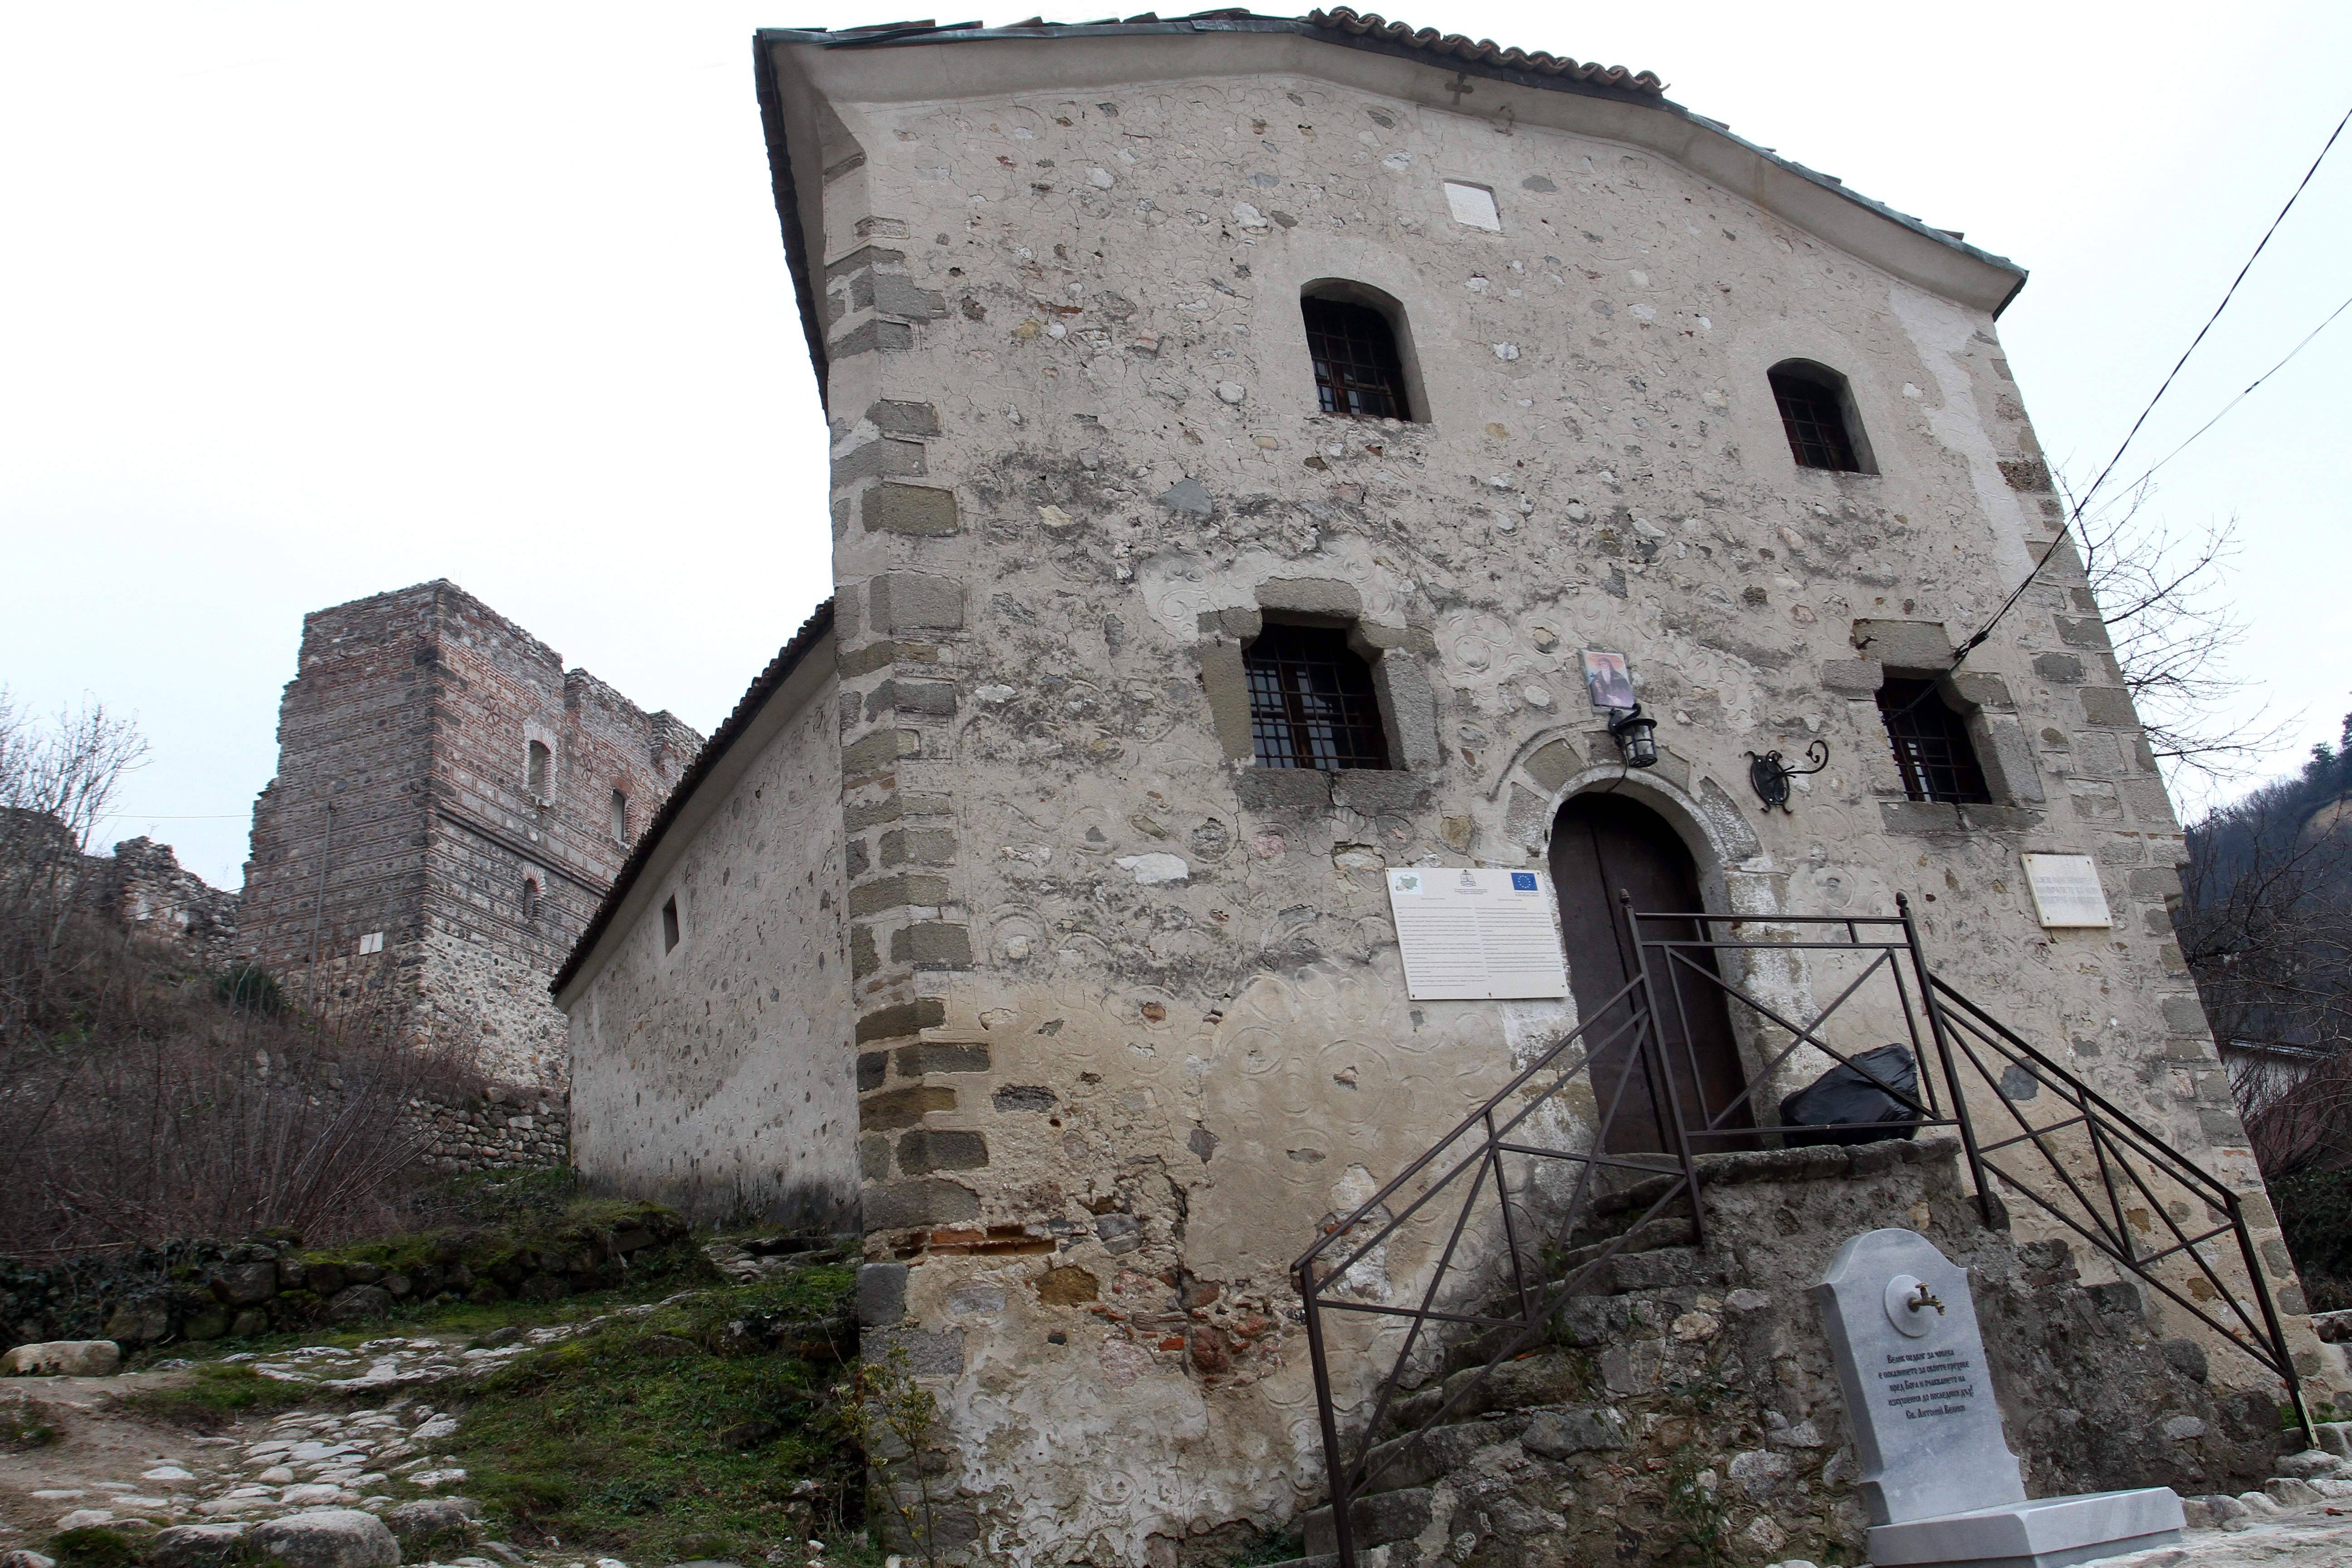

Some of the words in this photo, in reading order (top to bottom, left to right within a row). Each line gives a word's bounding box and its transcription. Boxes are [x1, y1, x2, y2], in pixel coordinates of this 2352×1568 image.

[1889, 1384, 1905, 1394] пред
[1904, 1380, 1919, 1389] Бога
[1923, 1394, 1929, 1403] до
[1906, 1410, 1916, 1419] Св.
